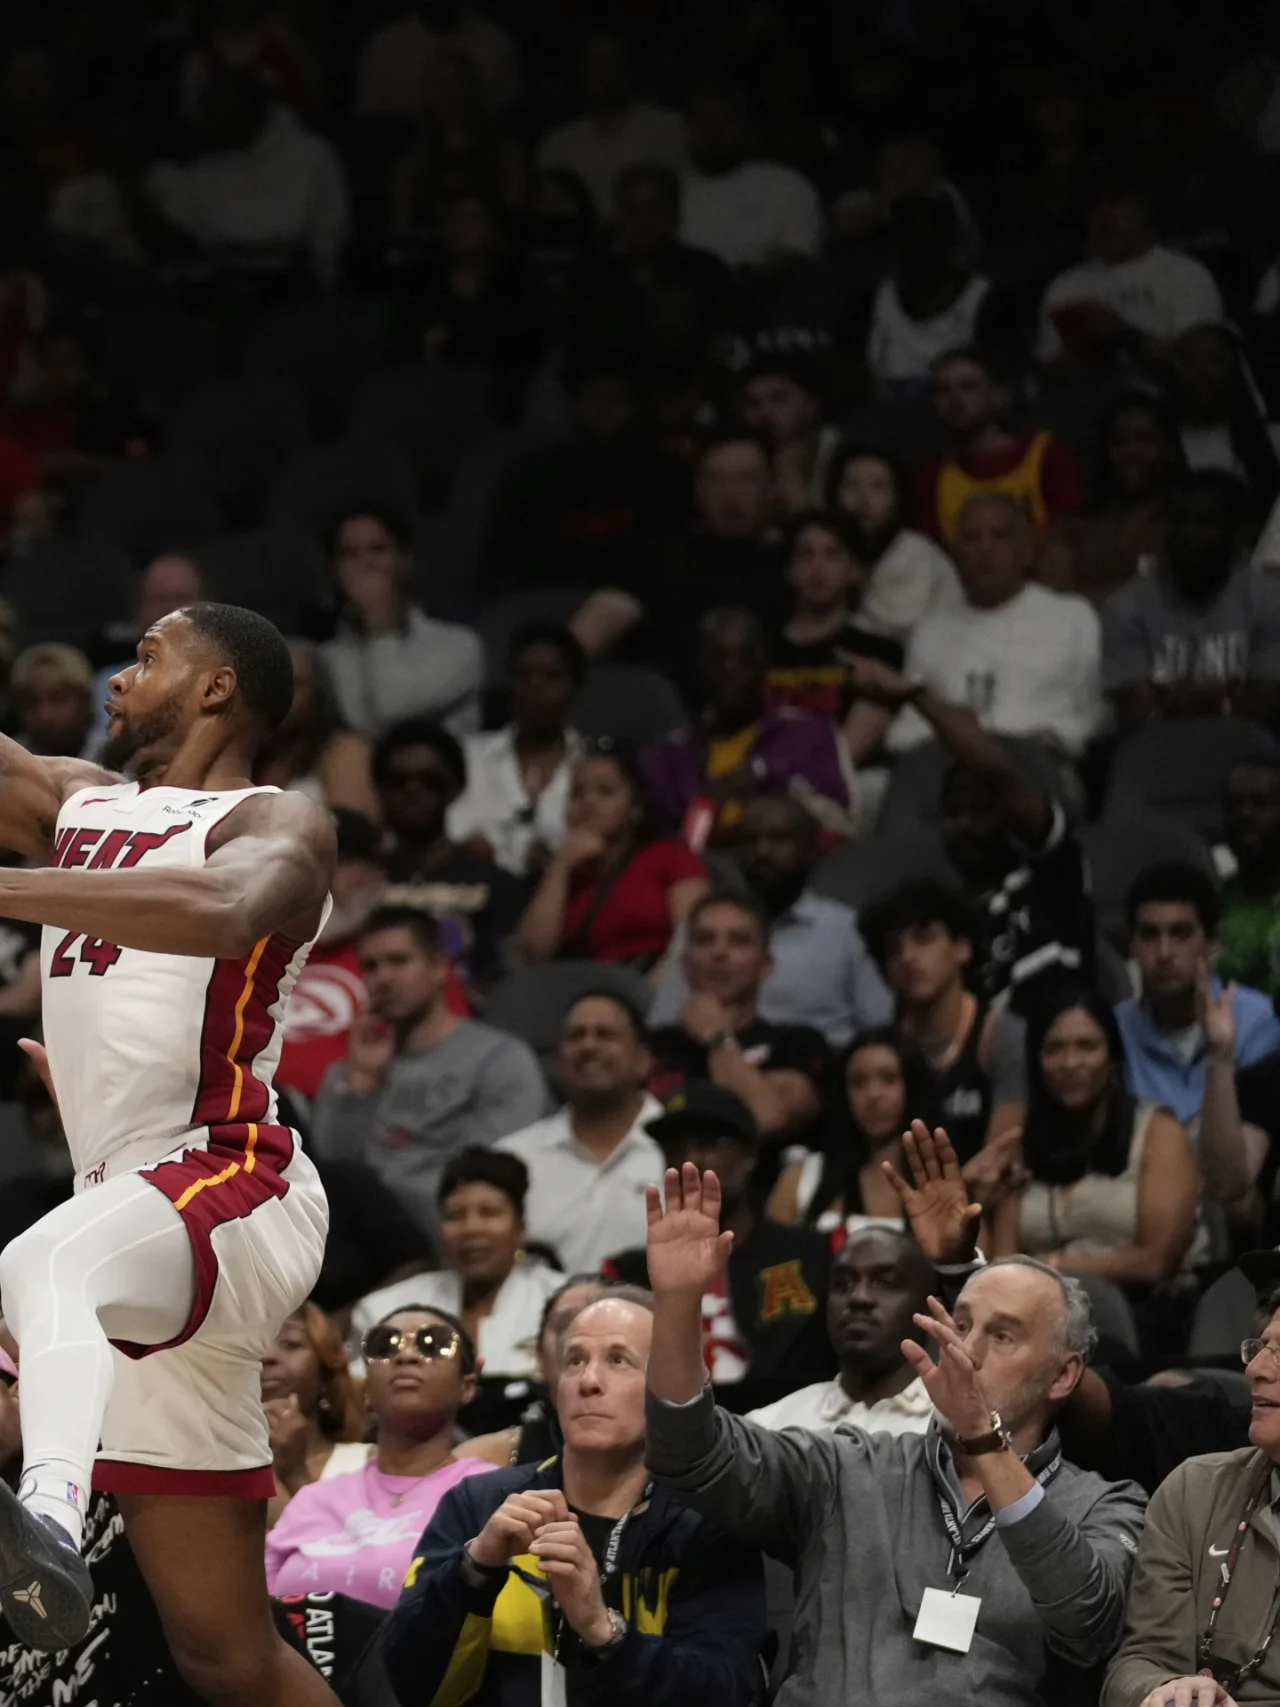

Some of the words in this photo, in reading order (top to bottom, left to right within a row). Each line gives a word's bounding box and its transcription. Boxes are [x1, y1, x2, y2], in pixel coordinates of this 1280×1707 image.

[51, 820, 193, 869] HEAT
[49, 930, 123, 978] 24
[759, 1257, 819, 1323] A
[299, 1561, 396, 1590] AIR
